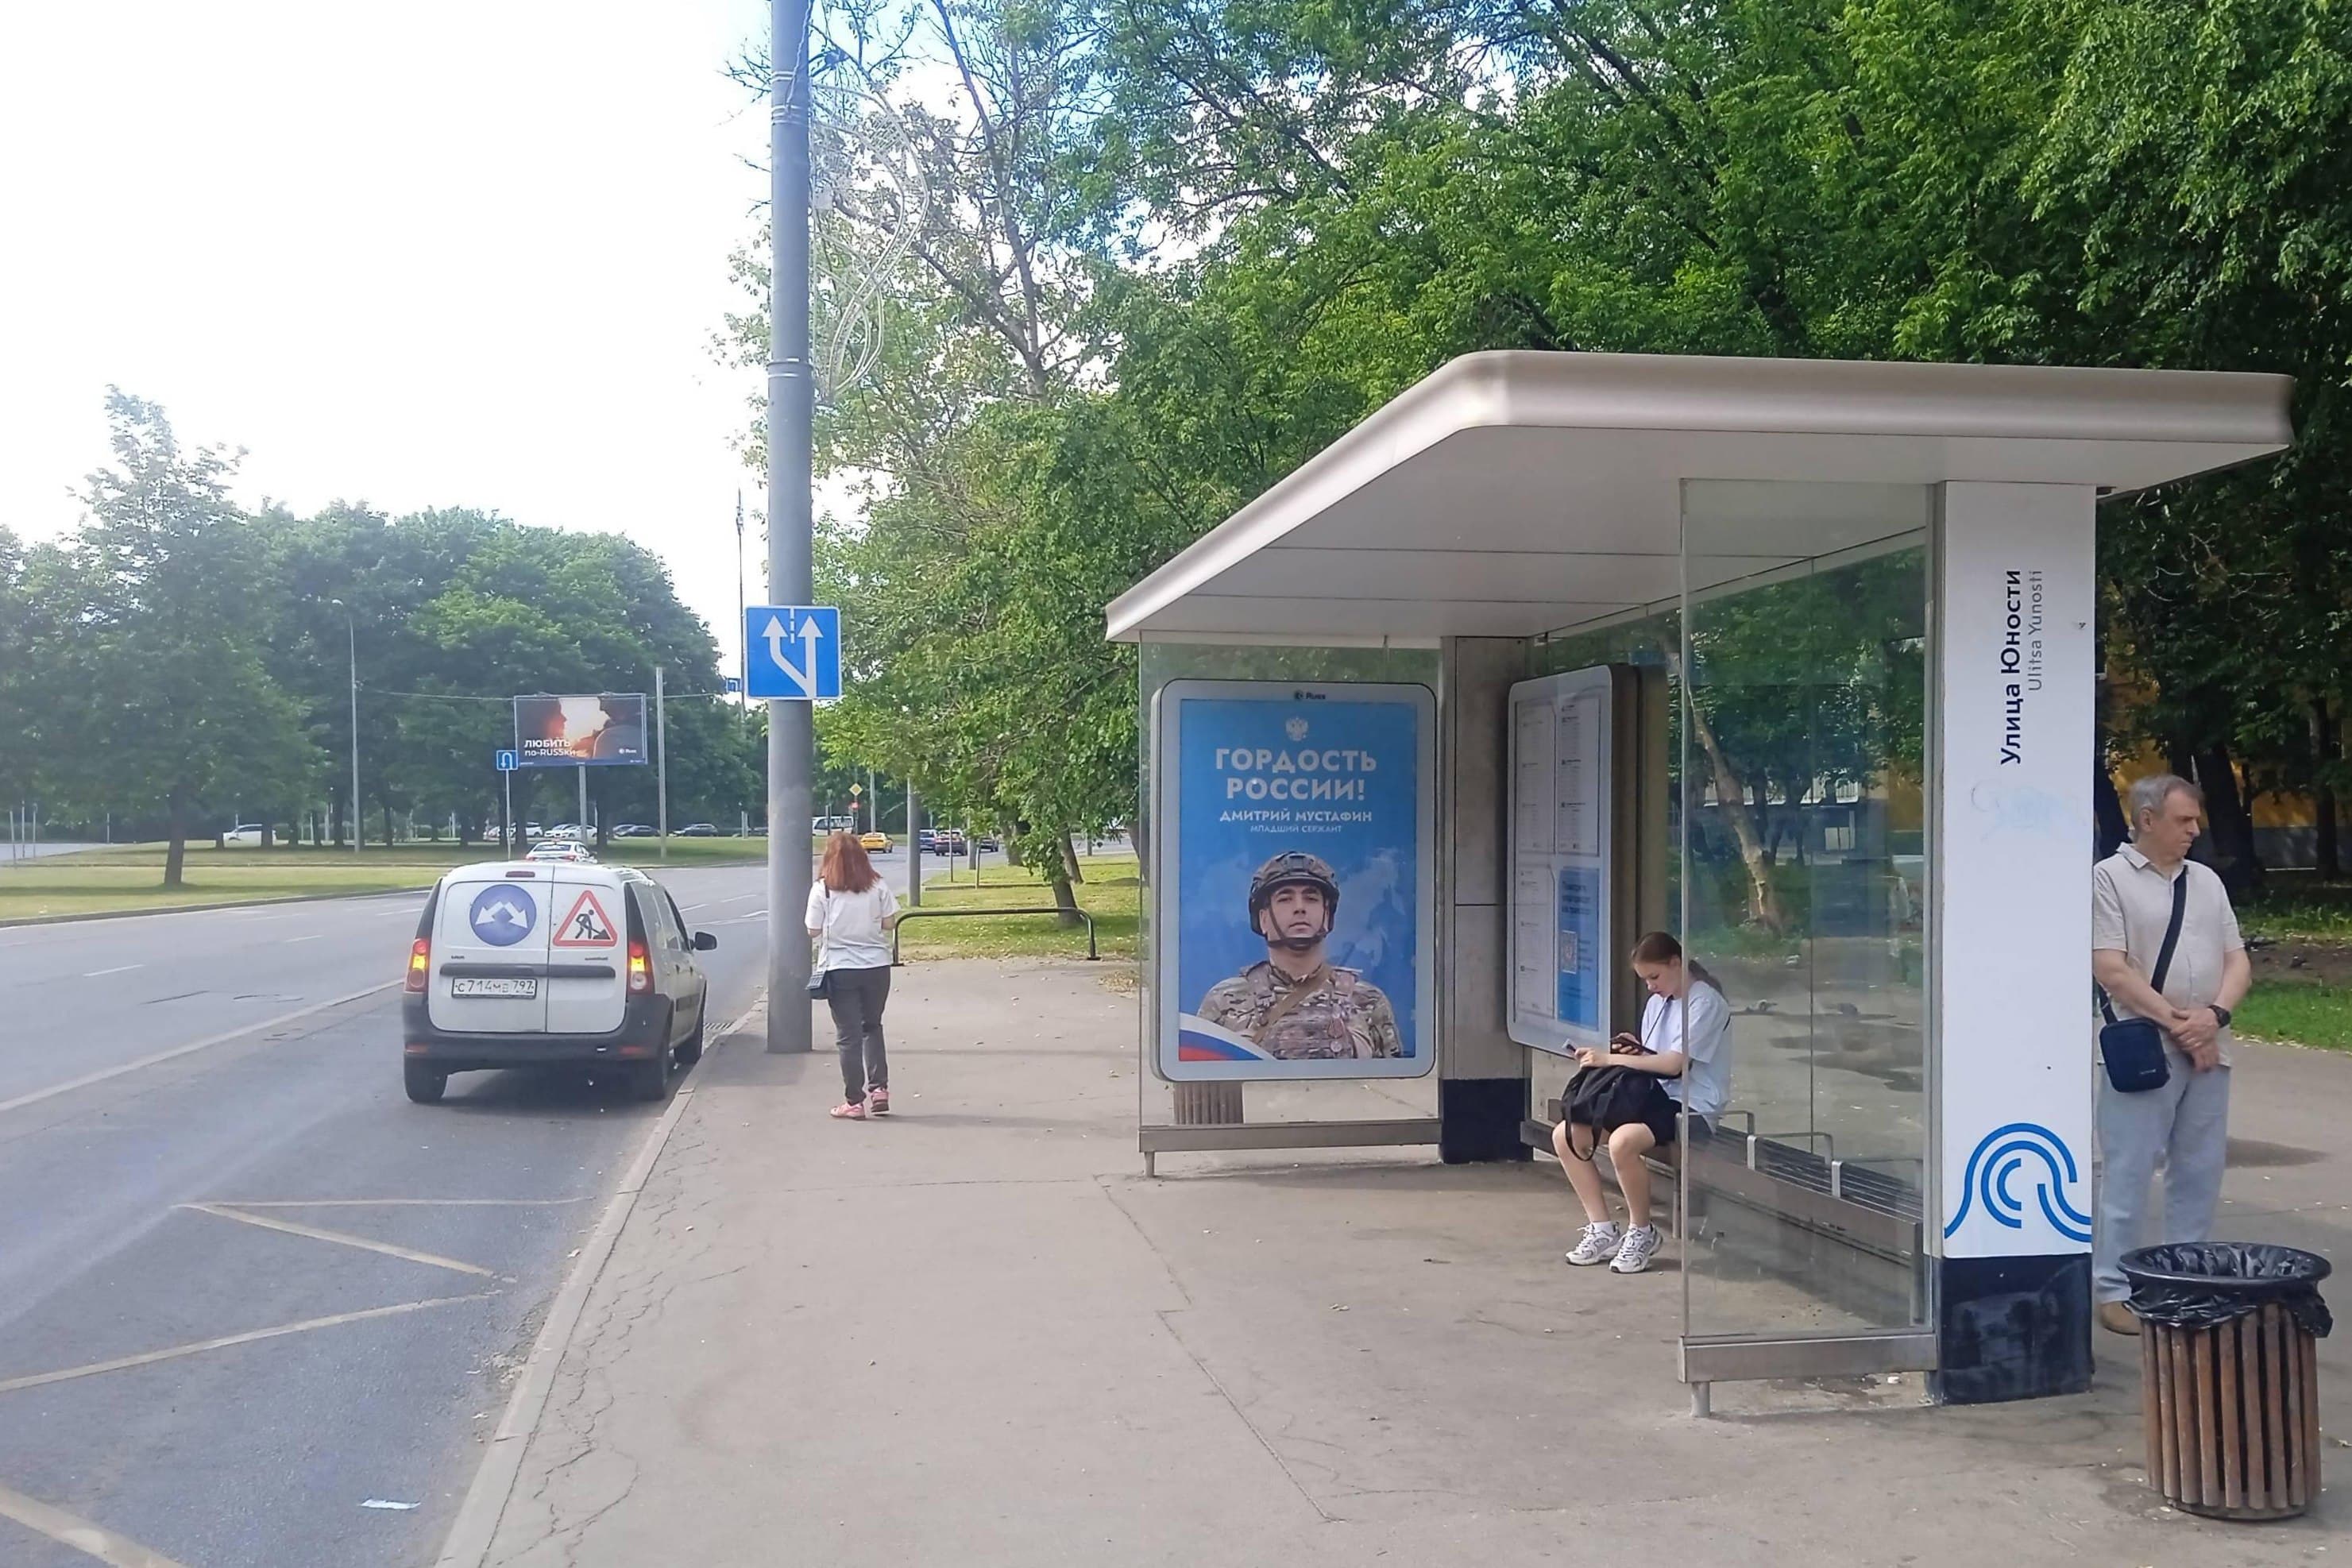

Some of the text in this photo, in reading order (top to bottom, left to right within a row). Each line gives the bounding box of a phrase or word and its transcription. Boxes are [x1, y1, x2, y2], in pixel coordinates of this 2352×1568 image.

[2027, 570, 2043, 691] Ulitsa Yunosti
[2000, 570, 2024, 765] Улица Юности
[523, 739, 571, 749] ЛЮБИТЬ
[1215, 747, 1377, 774] ГОРДОСТЬ
[1226, 777, 1365, 801] РОССИИ!
[1219, 807, 1373, 823] ДМИТРИЙ МУСТАФИН
